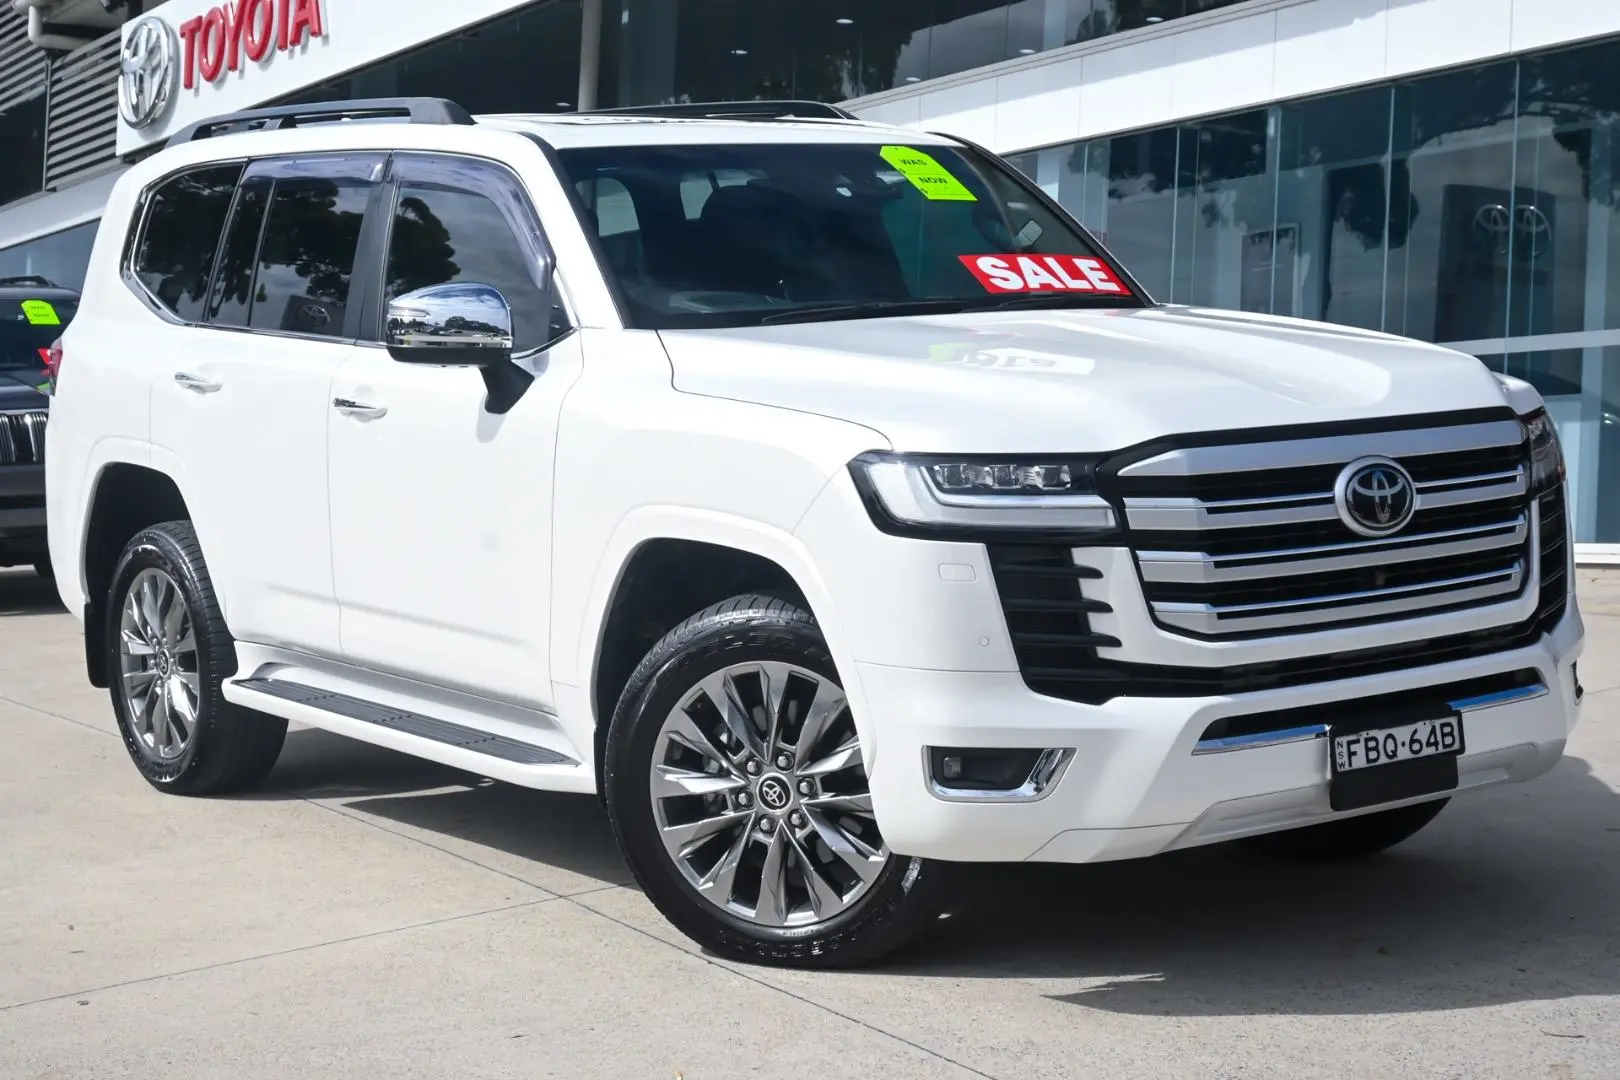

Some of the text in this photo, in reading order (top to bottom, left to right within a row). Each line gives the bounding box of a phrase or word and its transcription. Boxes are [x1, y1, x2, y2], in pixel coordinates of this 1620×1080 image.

[180, 0, 321, 89] TOYOTA
[898, 158, 928, 166] WAS
[976, 256, 1121, 291] SALE
[1337, 741, 1346, 770] NSW
